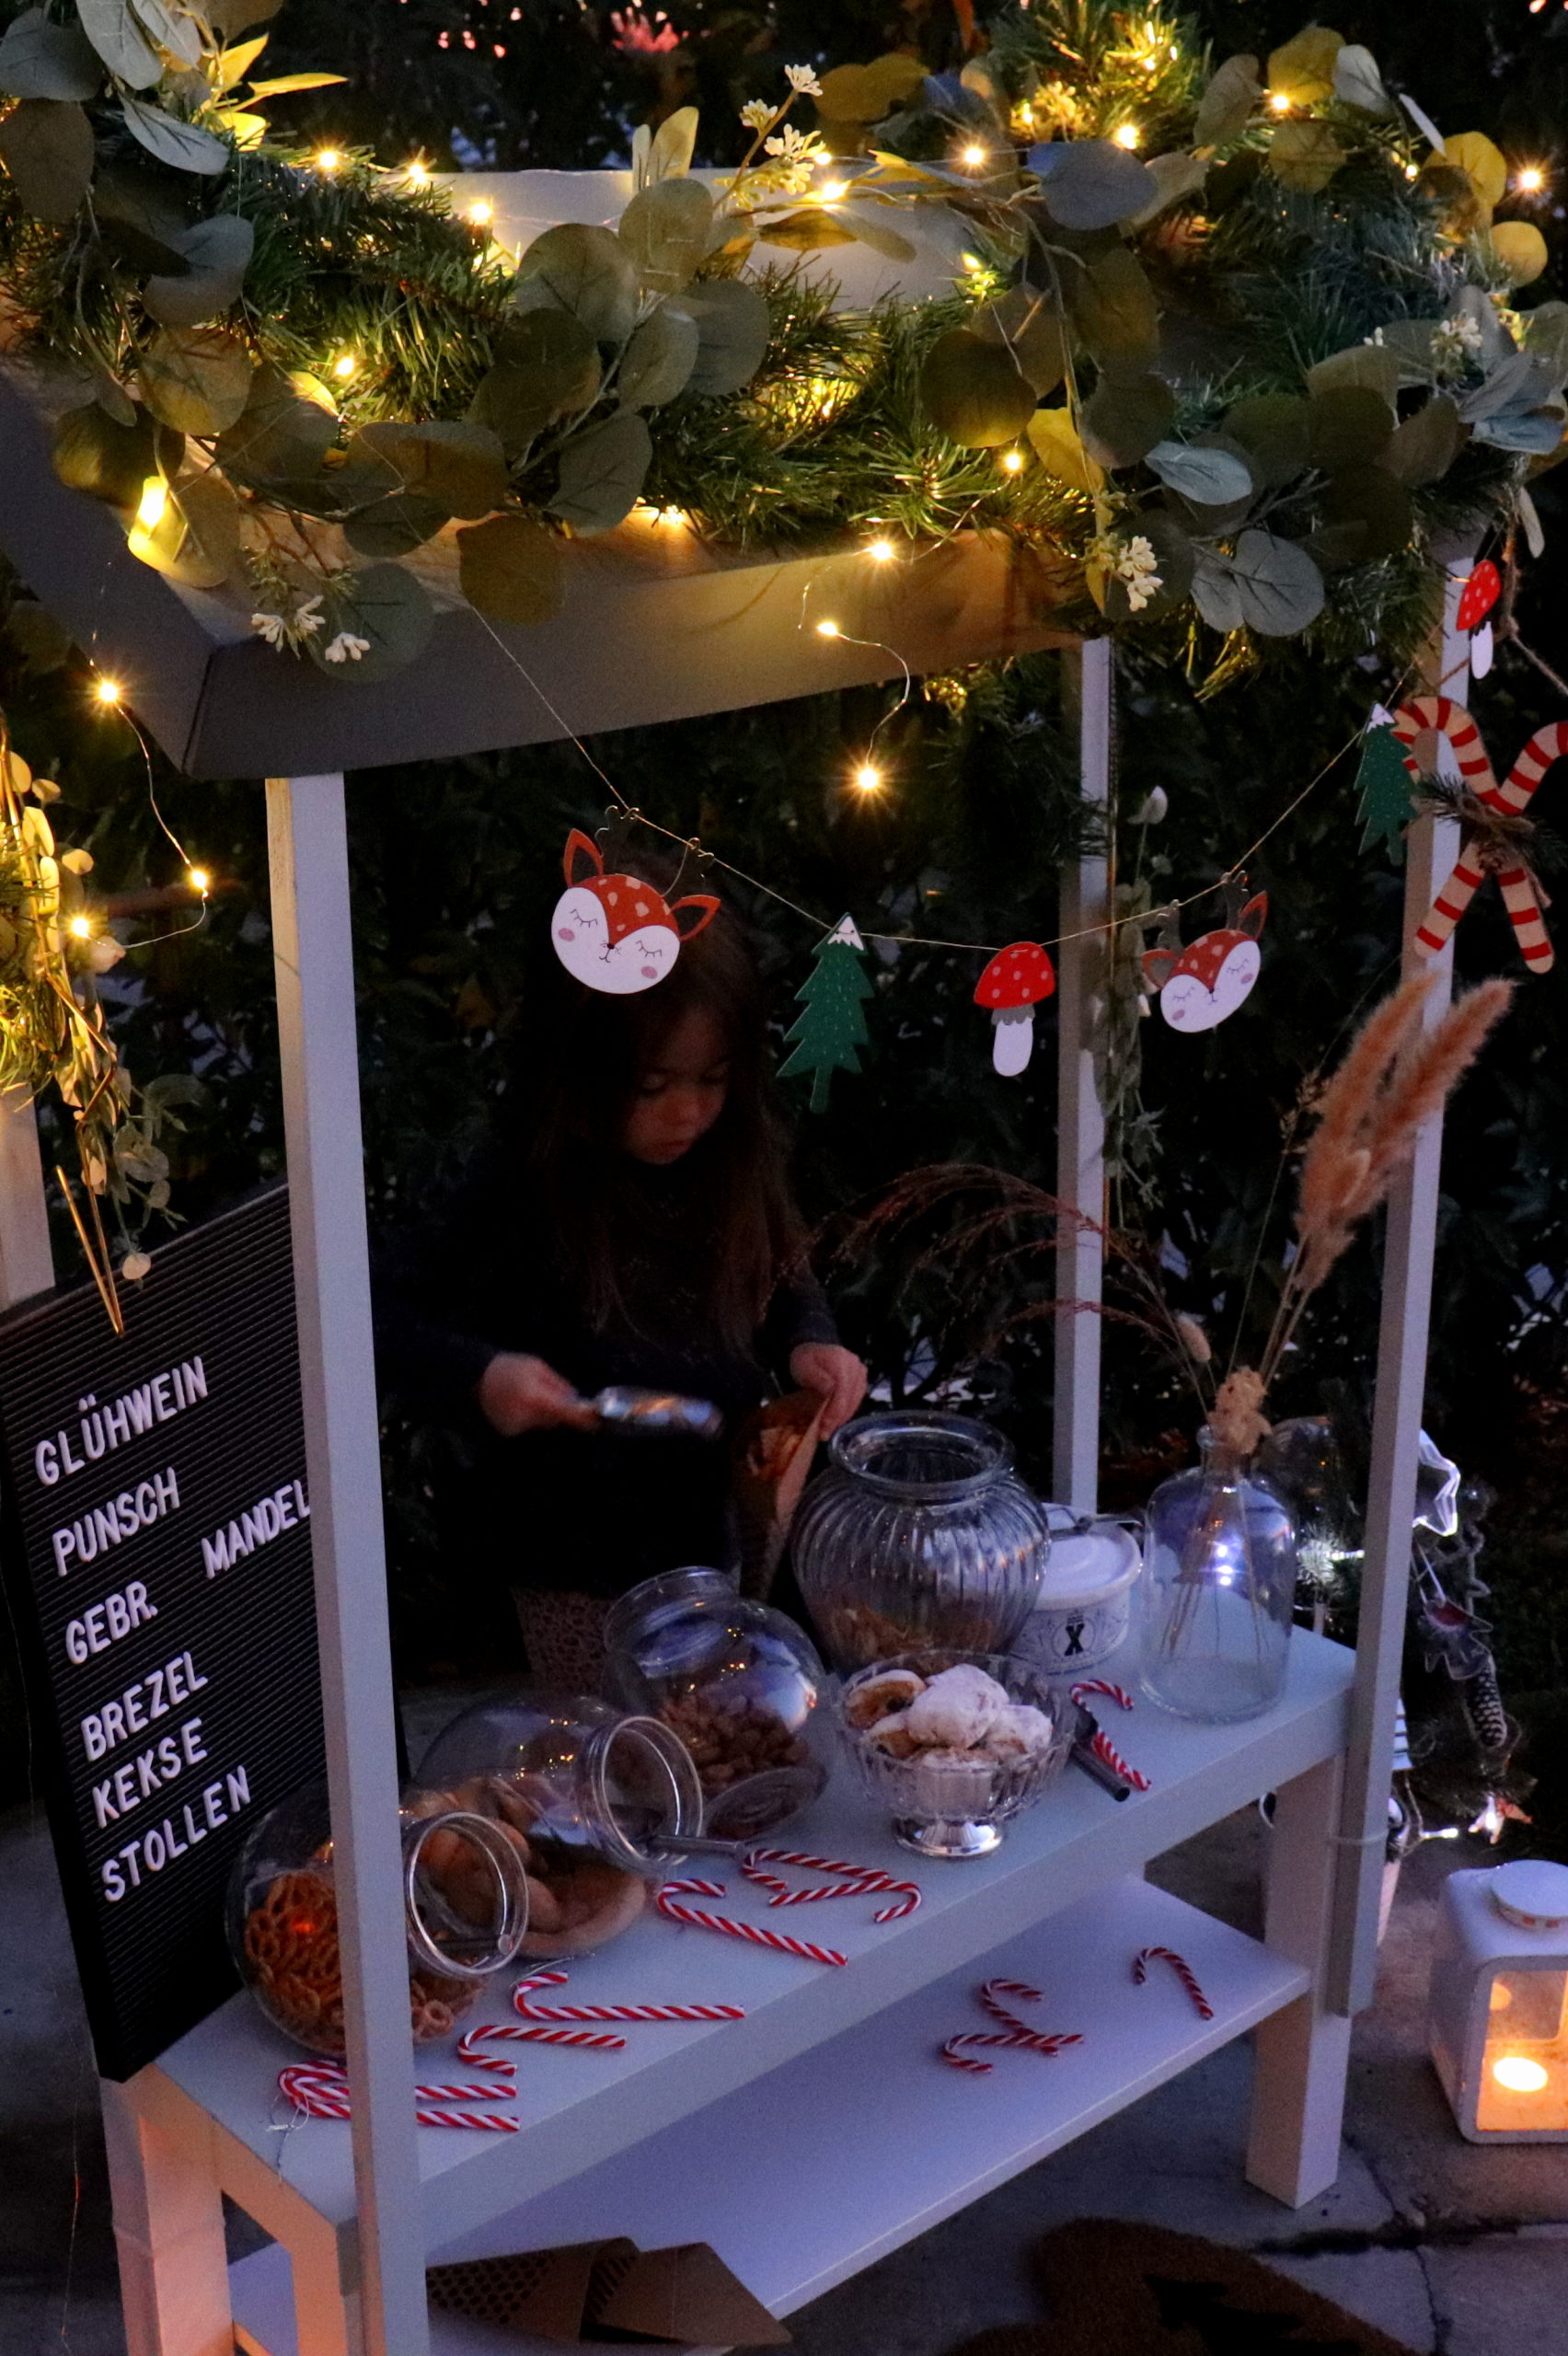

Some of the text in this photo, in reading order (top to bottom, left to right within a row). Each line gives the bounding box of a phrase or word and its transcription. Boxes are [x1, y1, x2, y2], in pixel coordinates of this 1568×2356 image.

[35, 1356, 209, 1485] GLÜHWEIN
[52, 1467, 180, 1576] PUNSCH
[65, 1480, 311, 1664] GEBR. MANDEL
[81, 1652, 209, 1761] BREZEL
[93, 1717, 208, 1829] KEKSE
[102, 1766, 251, 1902] STOLLEN
